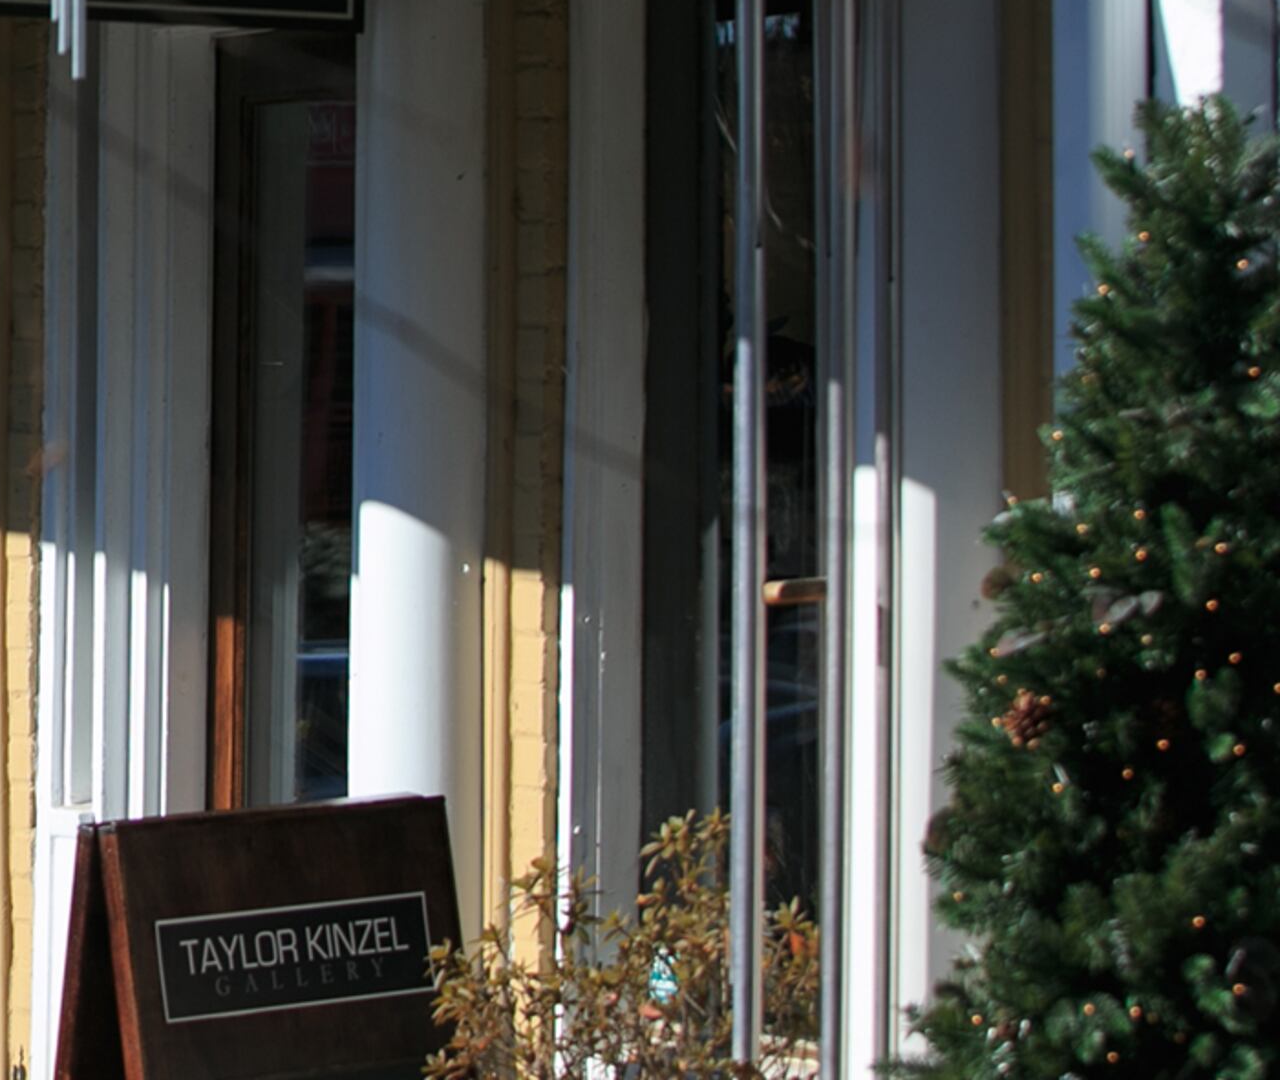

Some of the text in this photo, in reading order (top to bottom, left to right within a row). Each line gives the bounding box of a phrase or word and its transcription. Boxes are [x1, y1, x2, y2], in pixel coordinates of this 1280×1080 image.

[179, 916, 410, 976] TAYLOR KINZEL
[214, 957, 385, 998] GALLERY
